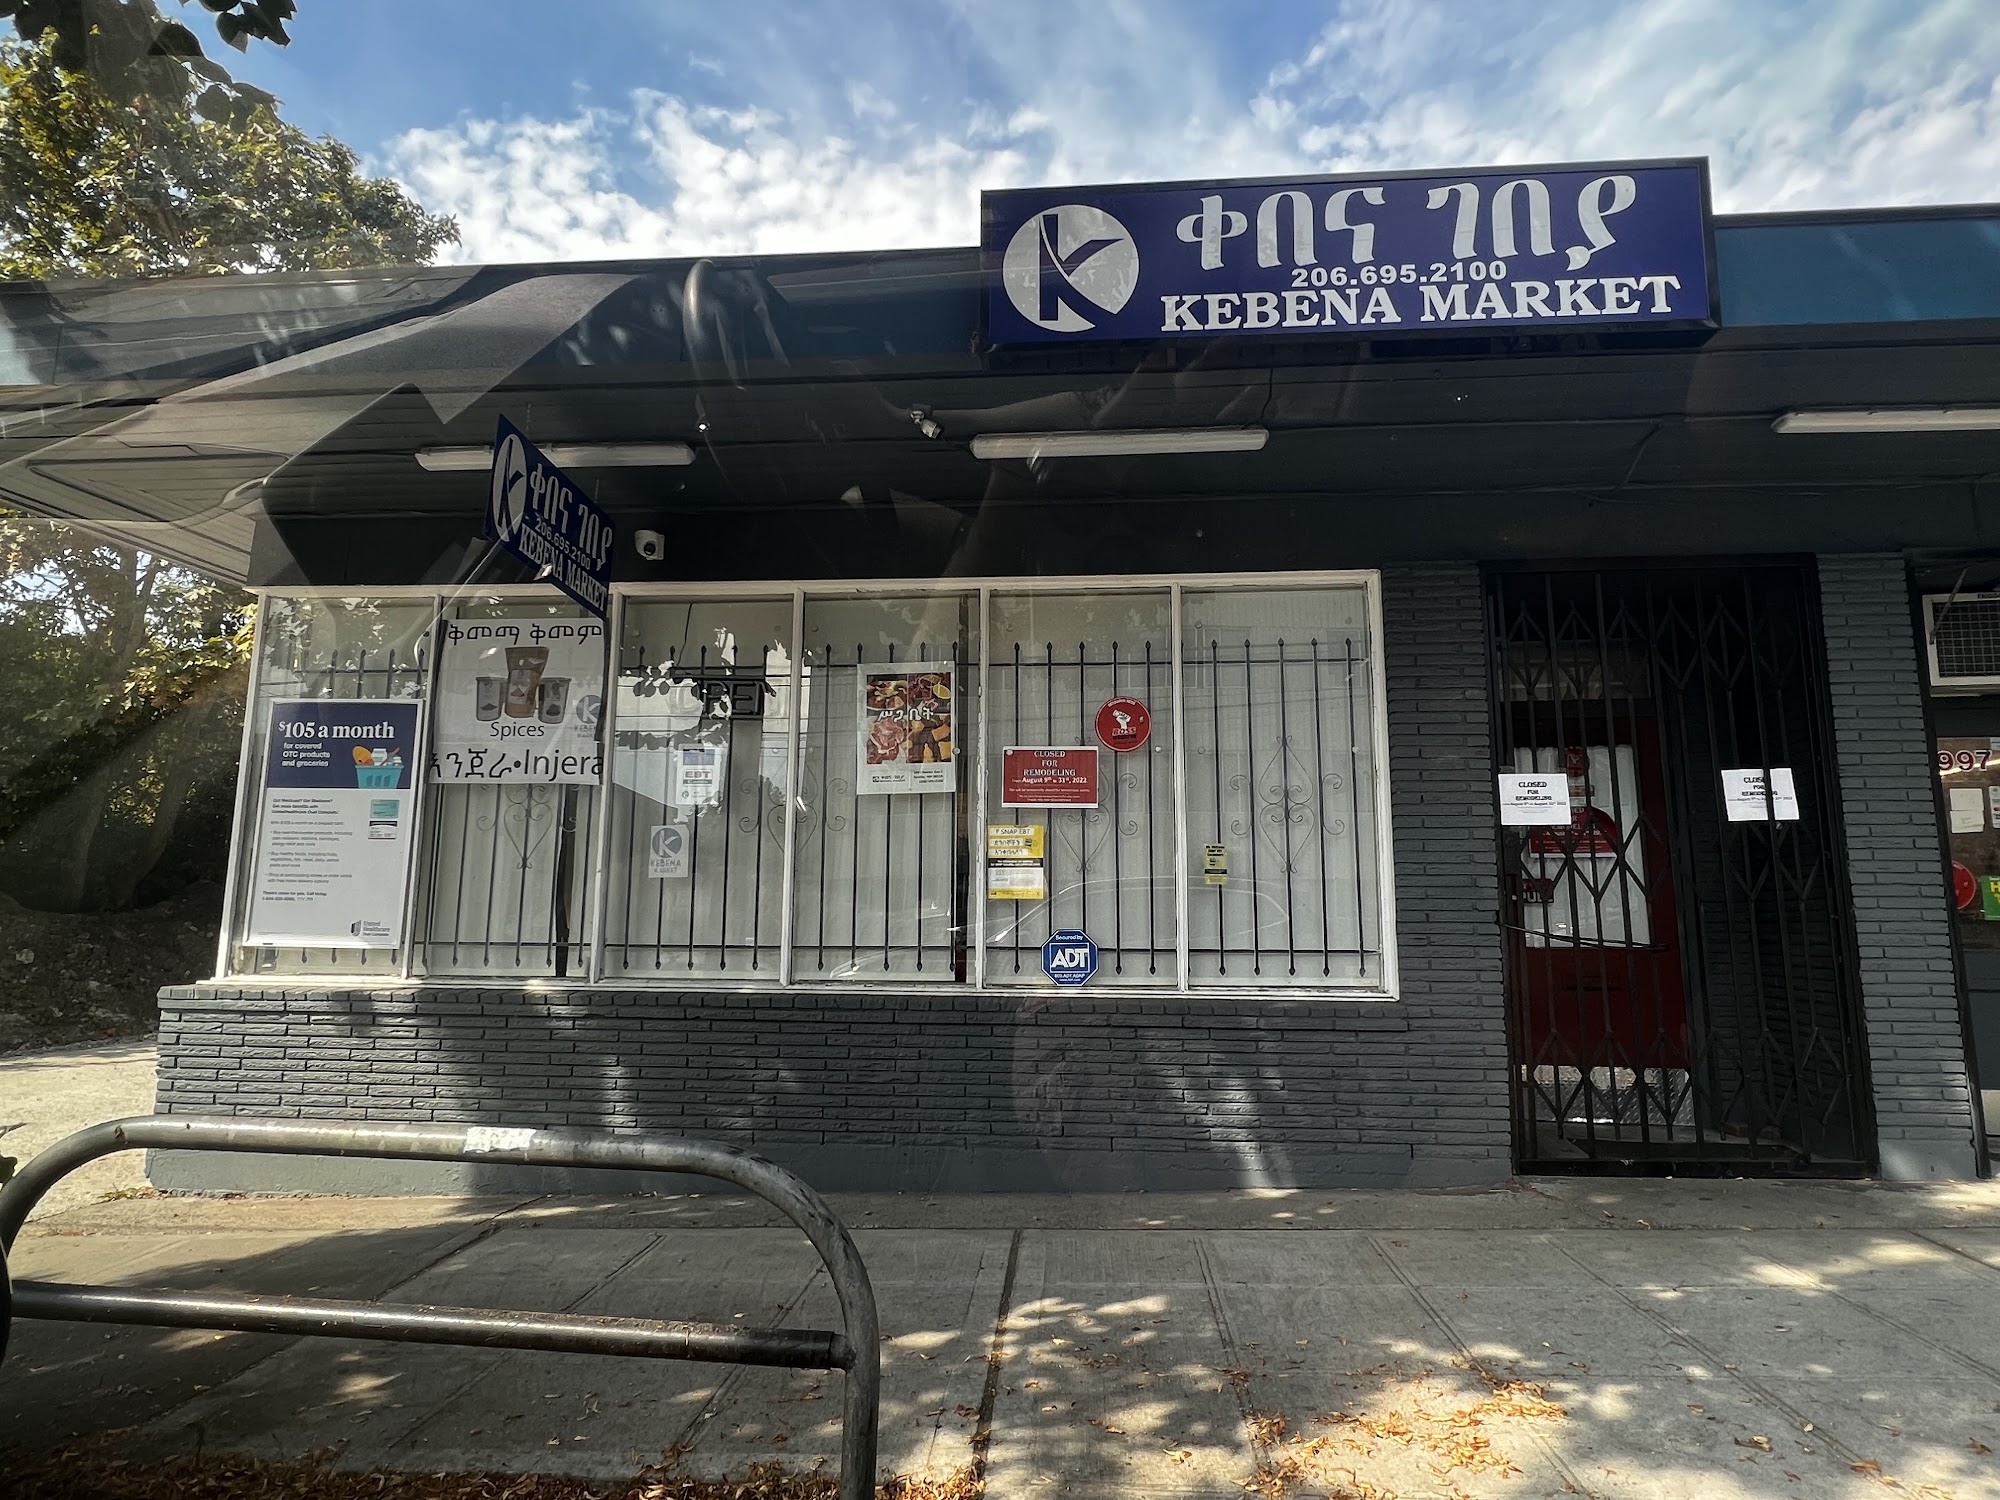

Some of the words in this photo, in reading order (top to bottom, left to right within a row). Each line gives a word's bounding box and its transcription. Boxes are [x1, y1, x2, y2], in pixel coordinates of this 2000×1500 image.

[1176, 187, 1385, 271] ቀበና
[1426, 175, 1637, 272] ገበያ
[1291, 260, 1507, 288] 206.695.2100
[1160, 287, 1401, 332] KEBENA
[1419, 276, 1680, 321] MARKET
[535, 518, 591, 570] 206.695.2100
[519, 523, 564, 581] KEBENA
[565, 559, 608, 612] MARKET
[448, 623, 520, 645] ቅመማ
[530, 623, 602, 645] ቅመም
[278, 721, 316, 738] $105
[318, 725, 329, 738] a
[332, 721, 395, 739] month
[490, 721, 545, 741] Spices
[1112, 726, 1137, 737] BOSS
[296, 760, 329, 768] groceries
[300, 751, 331, 759] products
[1034, 750, 1066, 758] CLOSED
[684, 770, 711, 779] EBT
[1022, 776, 1043, 784] August
[1051, 947, 1089, 968] ADT
